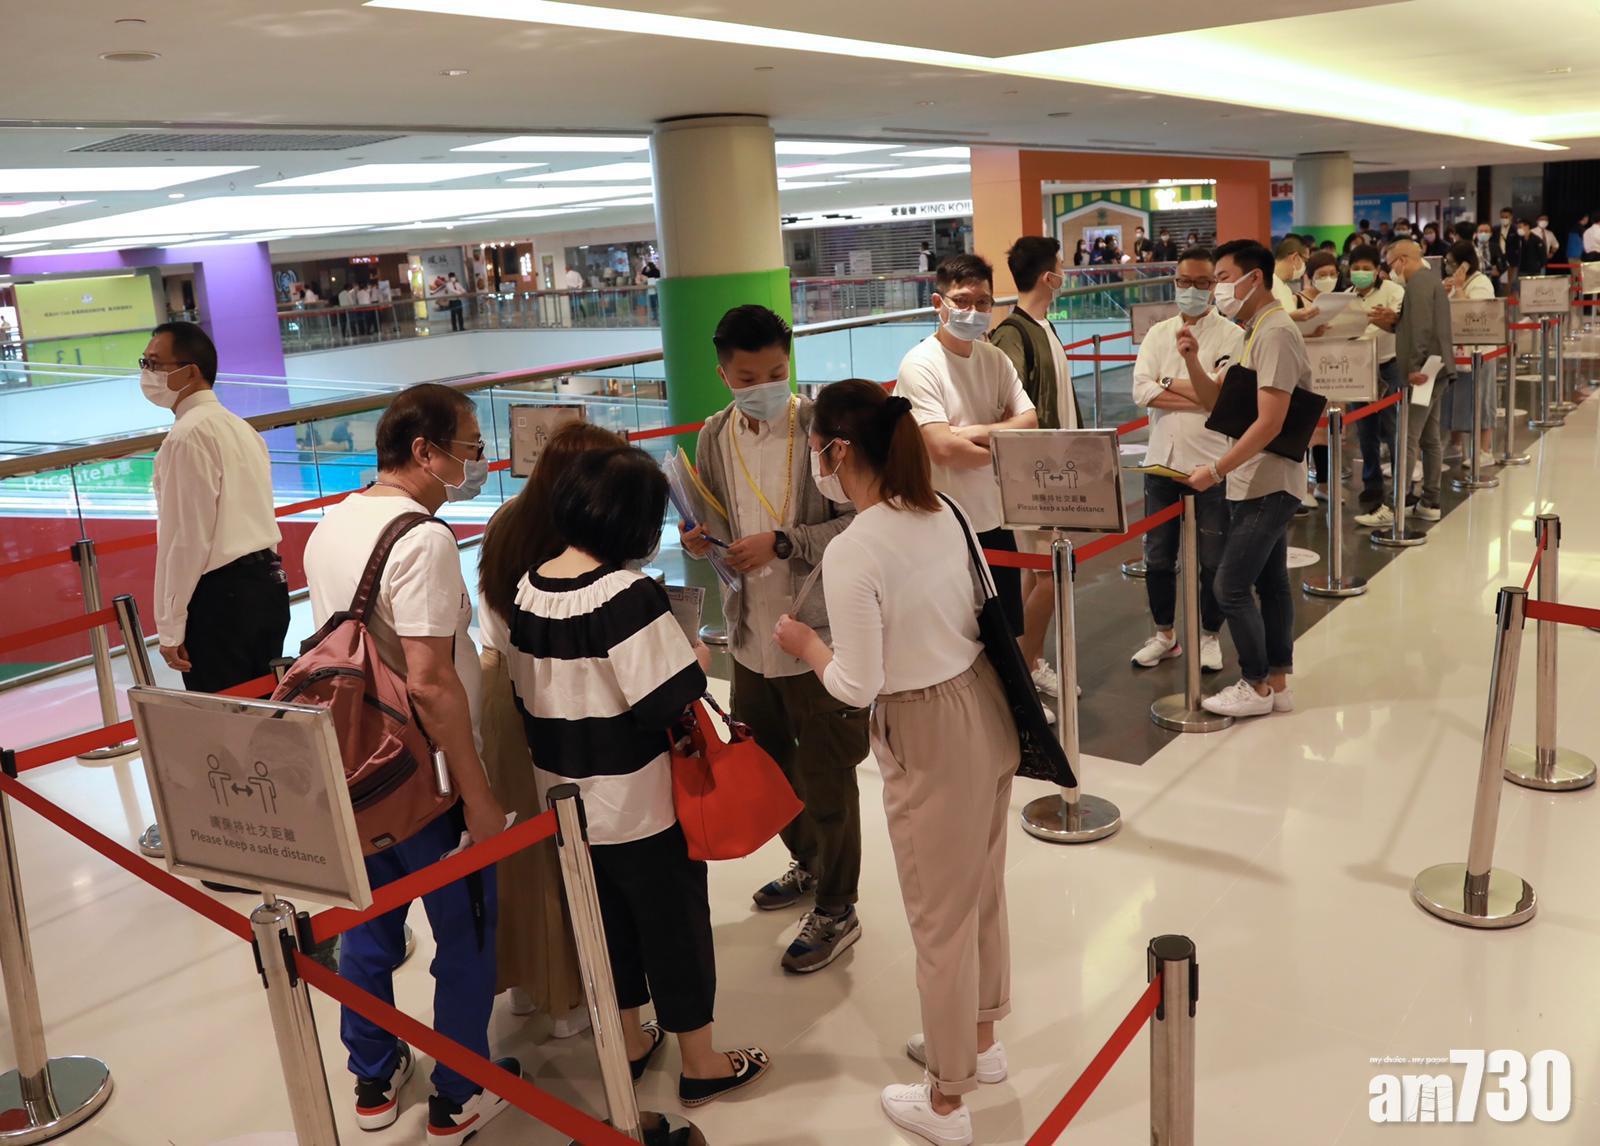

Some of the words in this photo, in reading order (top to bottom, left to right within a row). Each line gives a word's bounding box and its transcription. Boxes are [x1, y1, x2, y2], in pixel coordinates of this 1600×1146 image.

[920, 204, 946, 214] KING
[1017, 503, 1038, 511] Please
[1039, 504, 1055, 512] keep
[1061, 504, 1075, 512] safe
[1076, 505, 1104, 513] distance
[209, 815, 296, 842] 請保持社交距離
[190, 829, 221, 846] Please
[223, 835, 248, 852] keep
[249, 842, 256, 852] a
[257, 843, 279, 856] safe
[280, 847, 326, 865] distance
